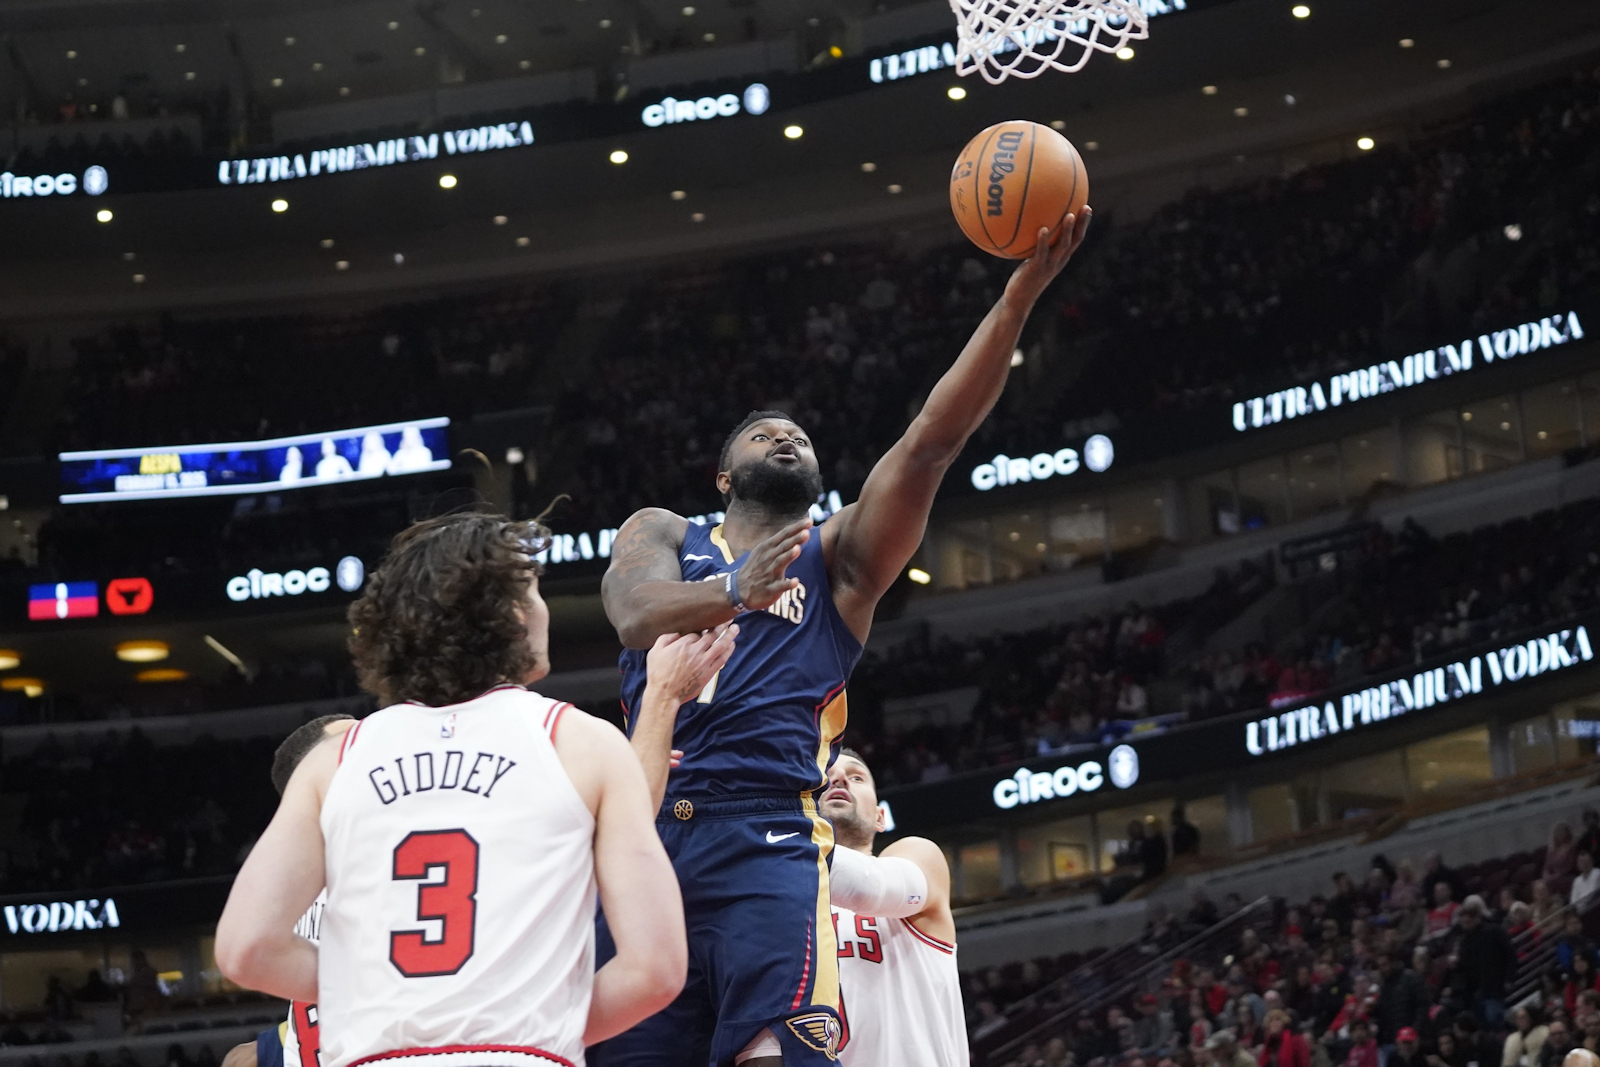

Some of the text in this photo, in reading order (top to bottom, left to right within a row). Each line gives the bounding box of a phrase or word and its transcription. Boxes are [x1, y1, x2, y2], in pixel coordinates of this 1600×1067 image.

[218, 121, 535, 184] ULTRA PREMIUM VODKA
[987, 131, 1025, 217] Wilson
[1233, 311, 1584, 431] ULTRA PREMIUM VODKA
[1246, 625, 1594, 756] ULTRA PREMIUM VODKA
[369, 751, 517, 805] GIDDEY
[4, 898, 120, 934] VODKA
[389, 828, 480, 979] 3
